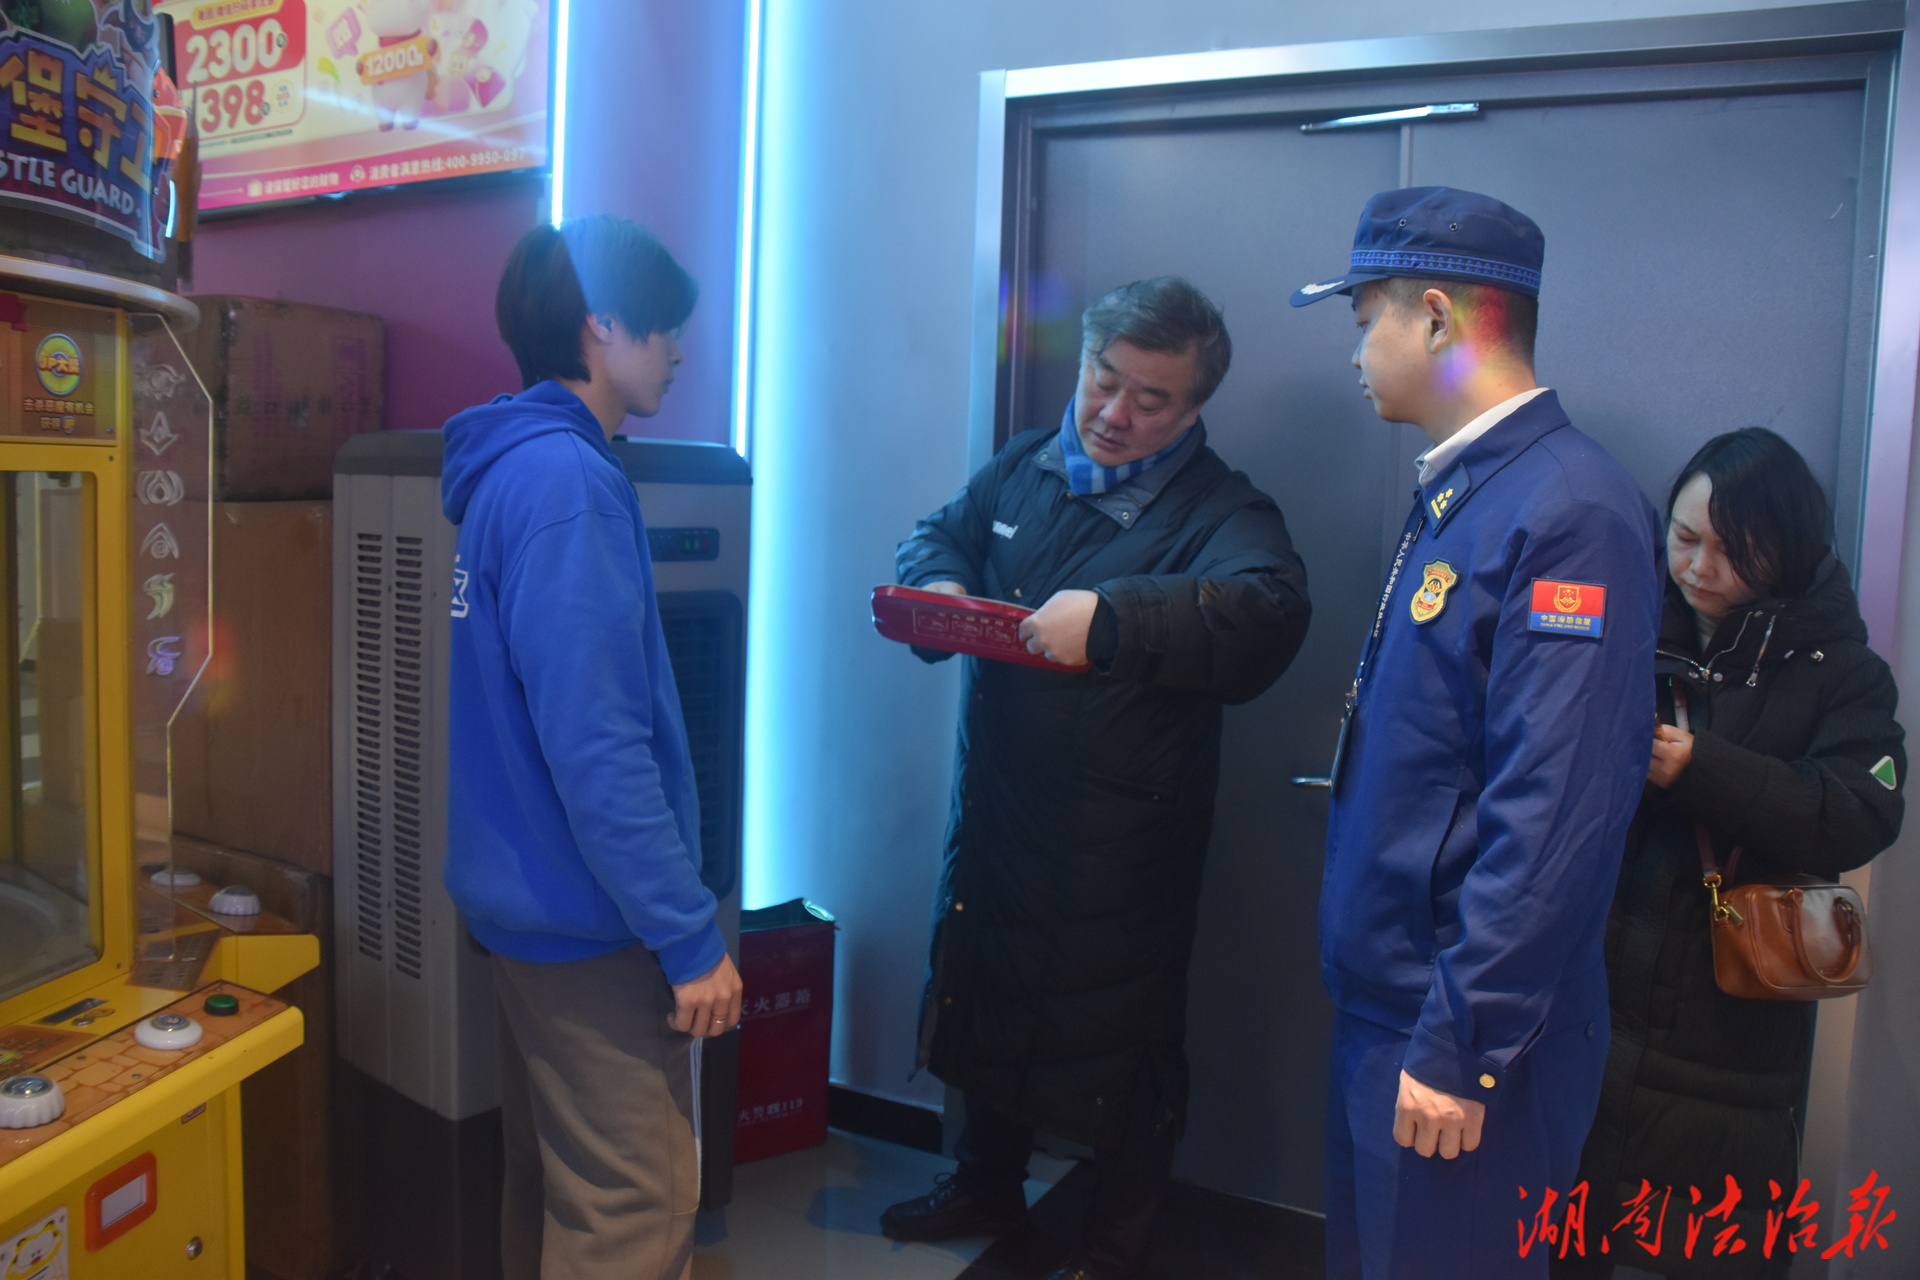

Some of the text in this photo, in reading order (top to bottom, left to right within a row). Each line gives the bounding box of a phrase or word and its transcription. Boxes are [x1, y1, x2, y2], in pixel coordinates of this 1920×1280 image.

[186, 18, 282, 84] 2300
[201, 79, 265, 134] 398
[61, 168, 135, 215] GUARD
